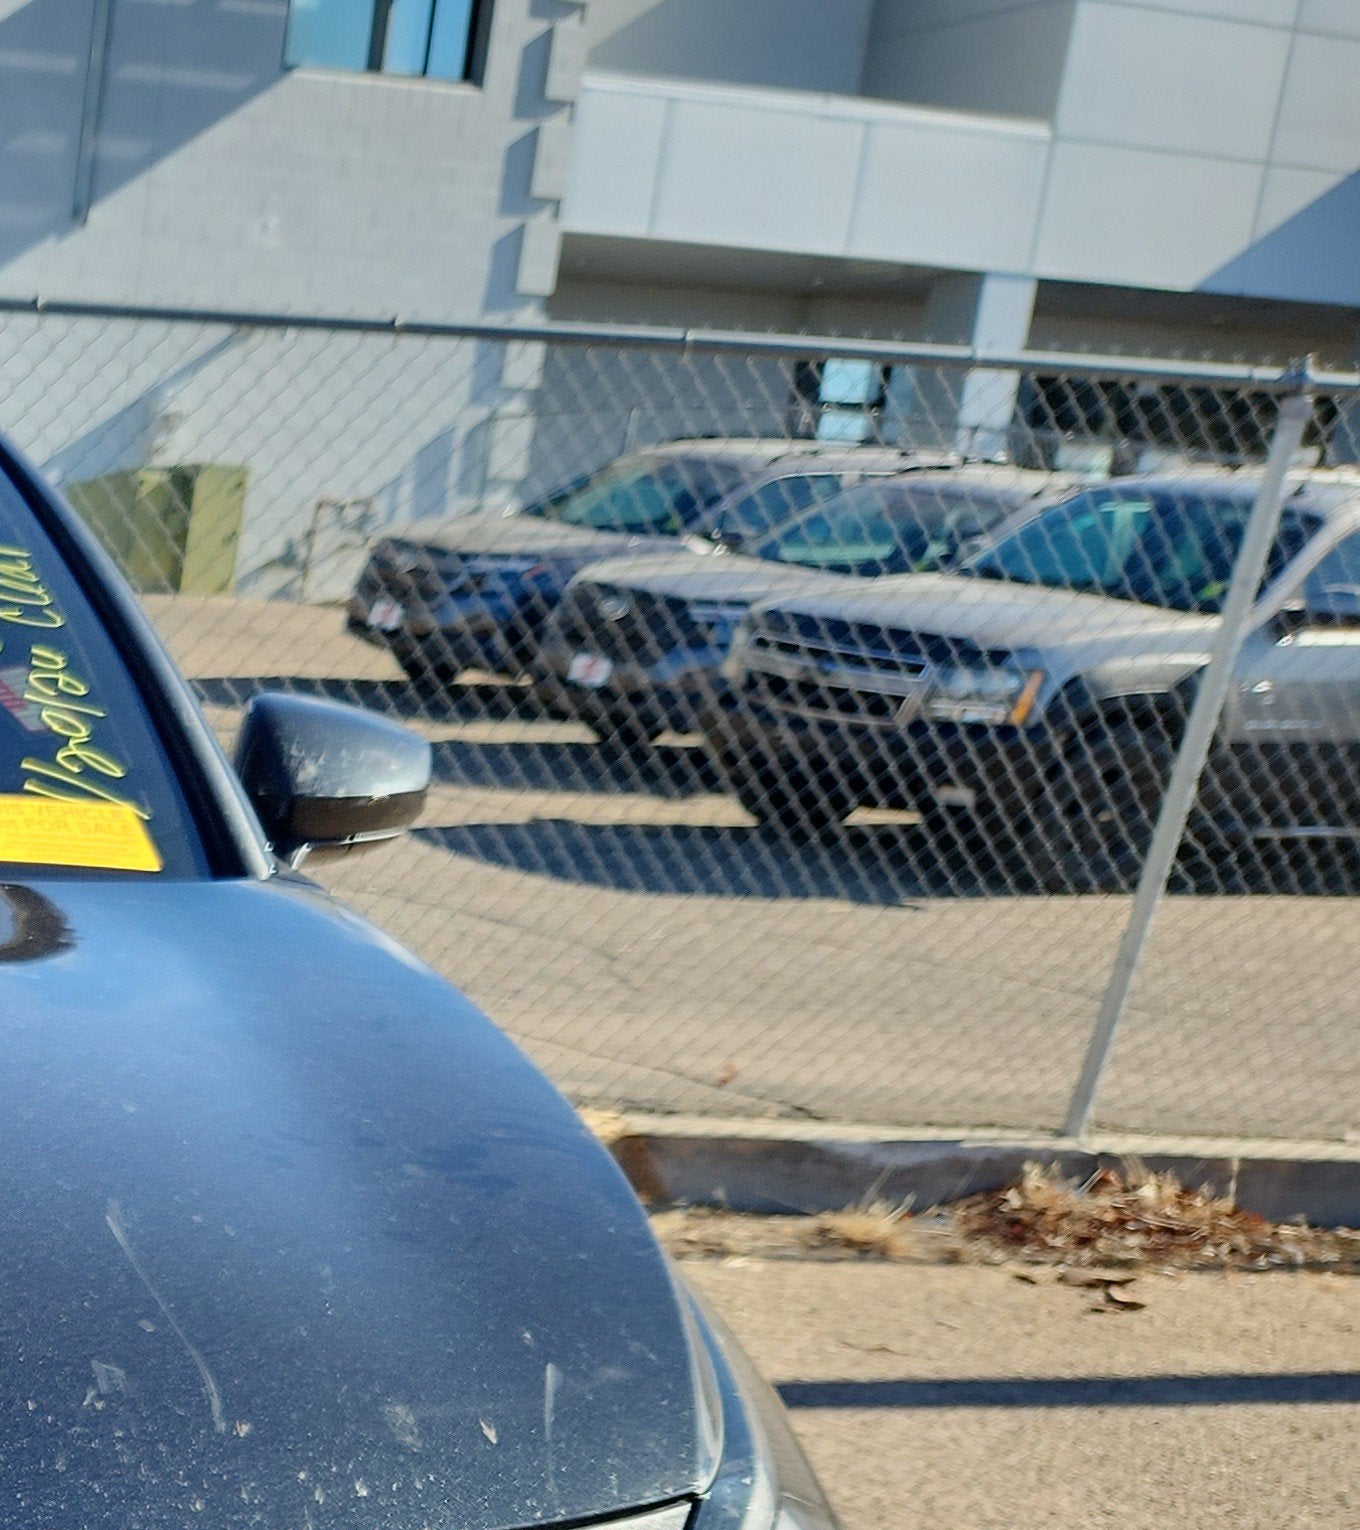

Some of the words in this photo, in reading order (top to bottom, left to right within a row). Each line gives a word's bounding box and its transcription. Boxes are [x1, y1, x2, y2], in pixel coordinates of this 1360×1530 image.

[31, 804, 127, 821] VEHICLE
[21, 818, 71, 832] FOR
[75, 821, 136, 836] SALE
